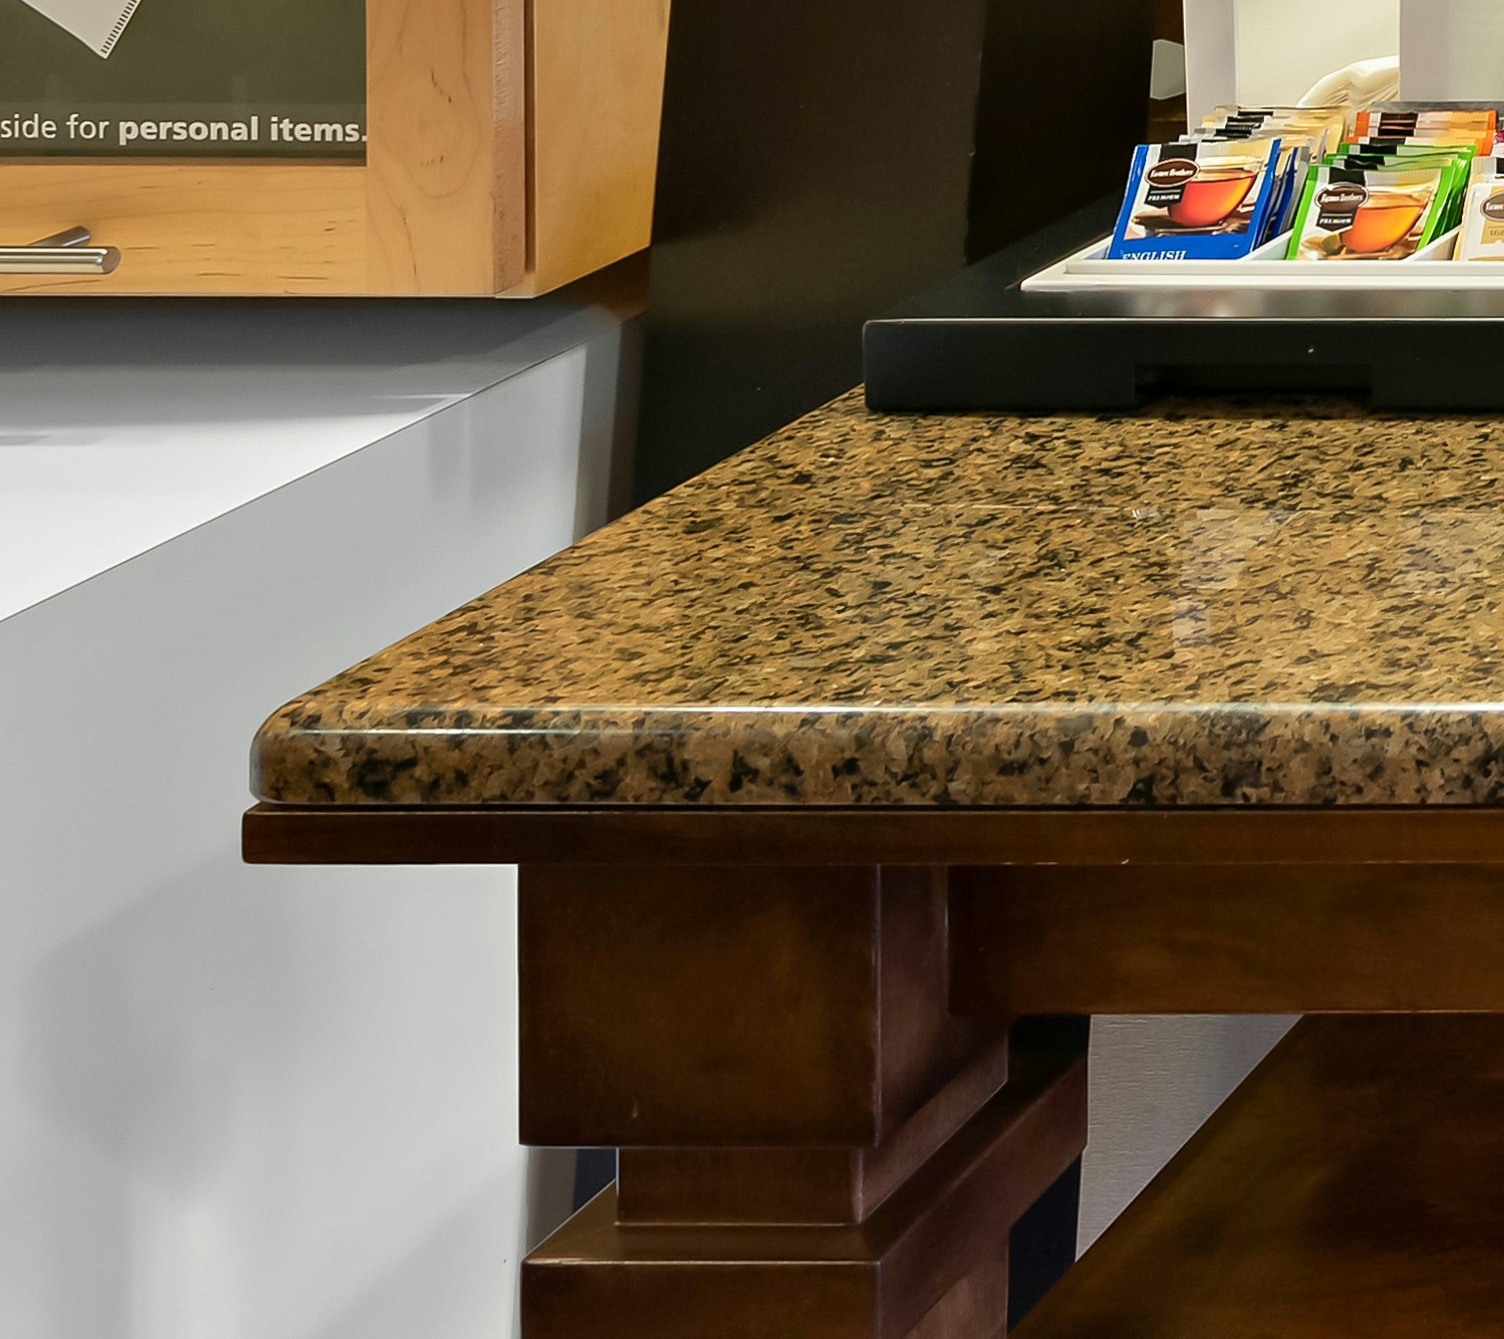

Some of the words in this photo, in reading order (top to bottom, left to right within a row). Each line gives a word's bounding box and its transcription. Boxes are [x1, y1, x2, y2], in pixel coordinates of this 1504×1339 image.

[66, 113, 110, 139] for
[118, 116, 259, 146] personal
[269, 116, 367, 142] items.
[1122, 250, 1187, 260] ENGLISH
